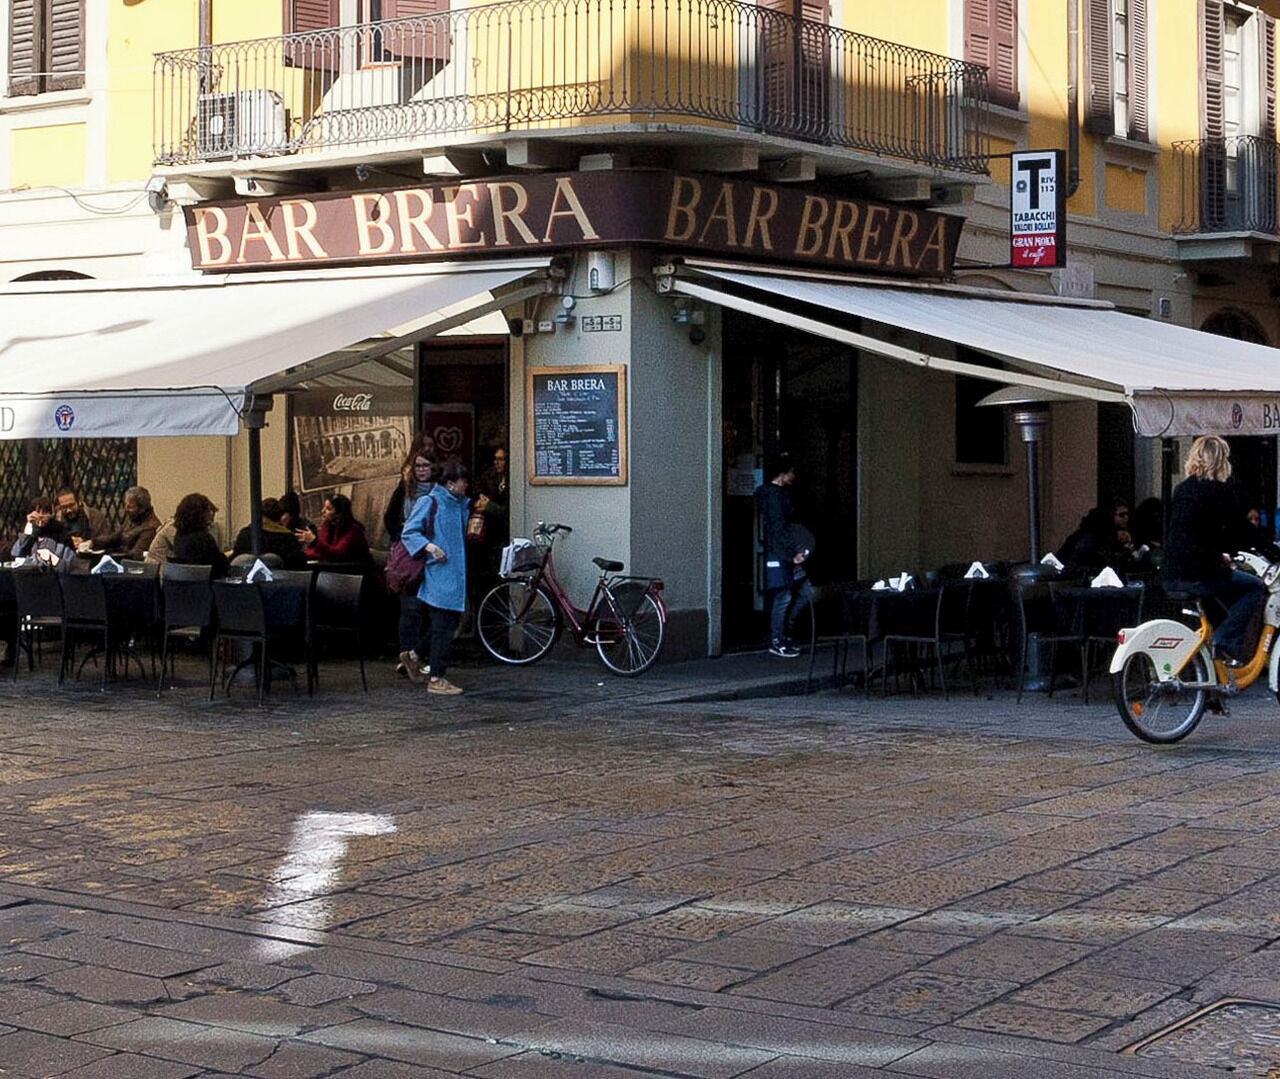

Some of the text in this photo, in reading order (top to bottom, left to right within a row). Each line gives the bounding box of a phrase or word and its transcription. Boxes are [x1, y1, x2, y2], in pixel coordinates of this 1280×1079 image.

[1018, 158, 1051, 209] T
[192, 177, 601, 266] BAR BRERA
[664, 175, 947, 271] BAR BRERA
[1015, 211, 1055, 222] TABACCHI
[547, 379, 606, 391] BAR BRERA
